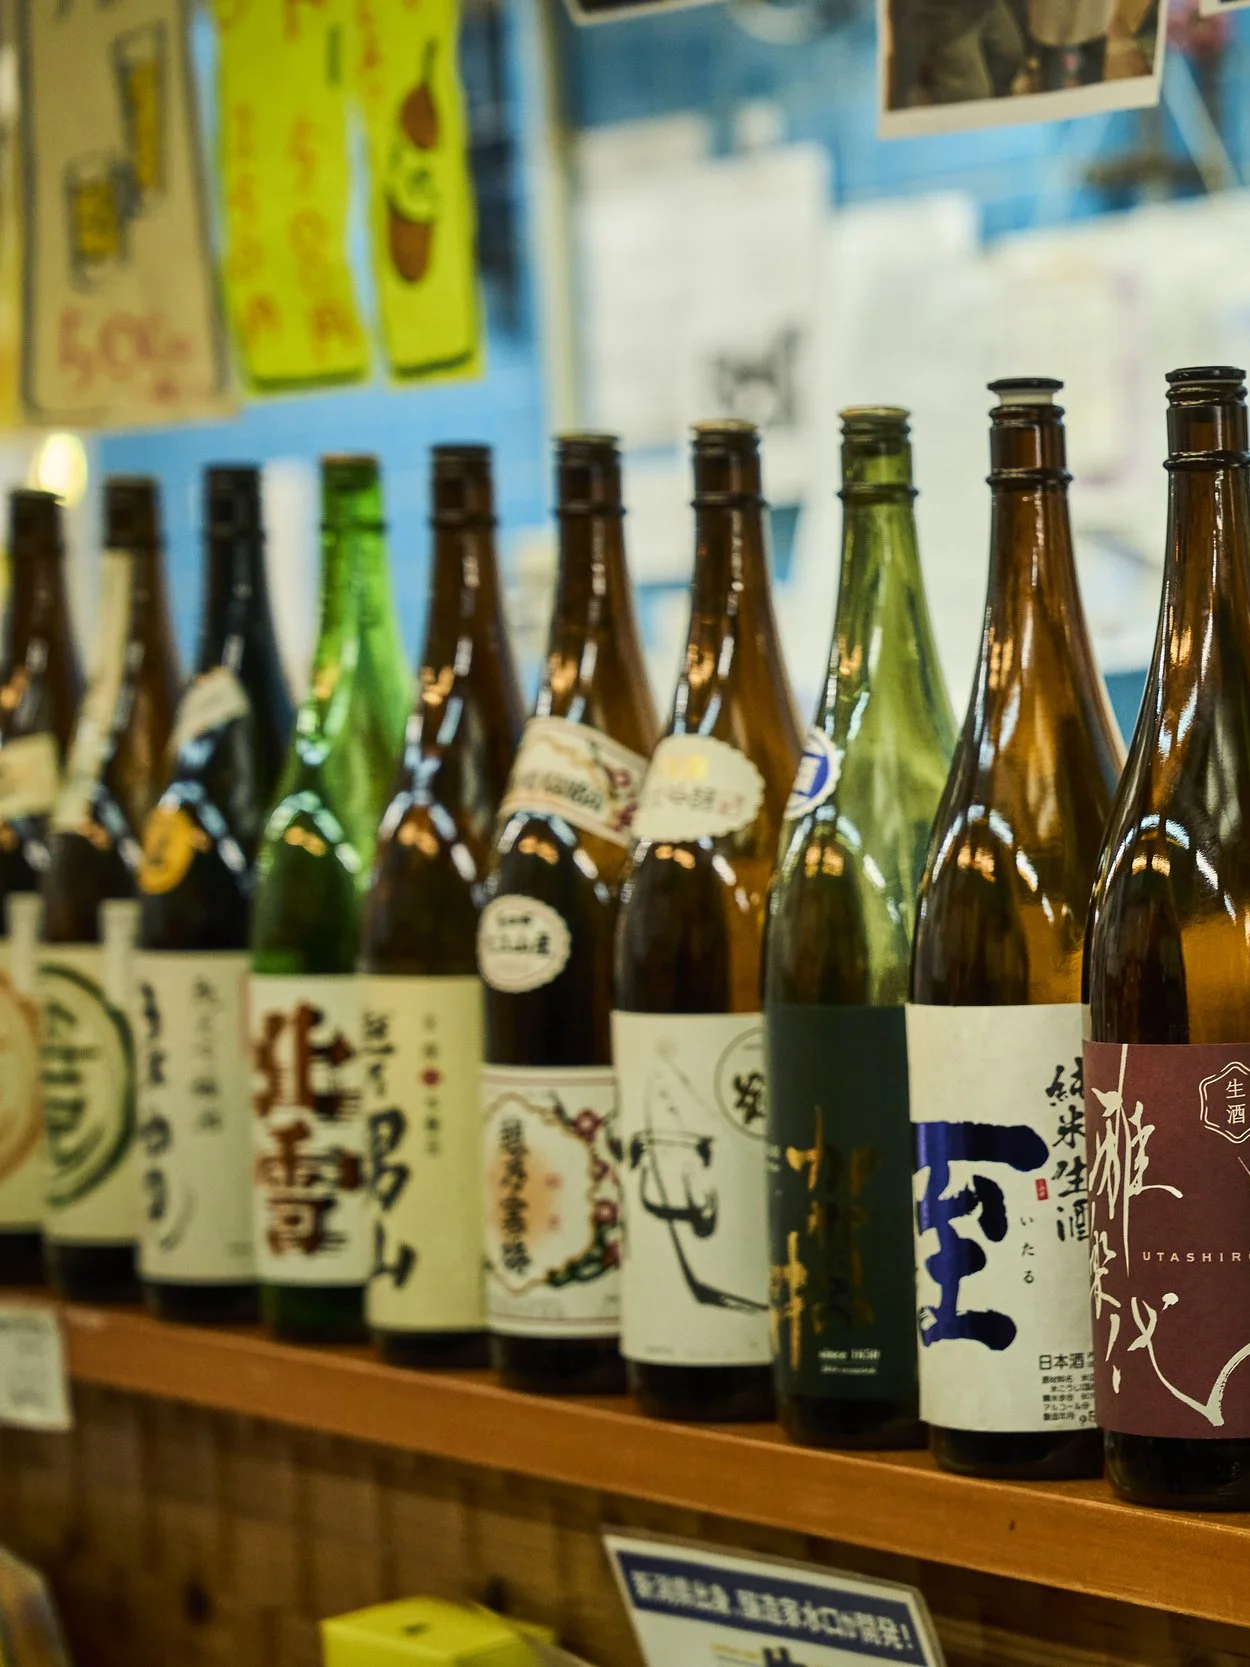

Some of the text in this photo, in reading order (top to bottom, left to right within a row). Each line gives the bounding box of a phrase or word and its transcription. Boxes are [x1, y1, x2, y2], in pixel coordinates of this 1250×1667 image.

[1225, 1079, 1246, 1125] 生酒
[1019, 1215, 1035, 1285] いたる
[1039, 1353, 1085, 1370] 日本酒
